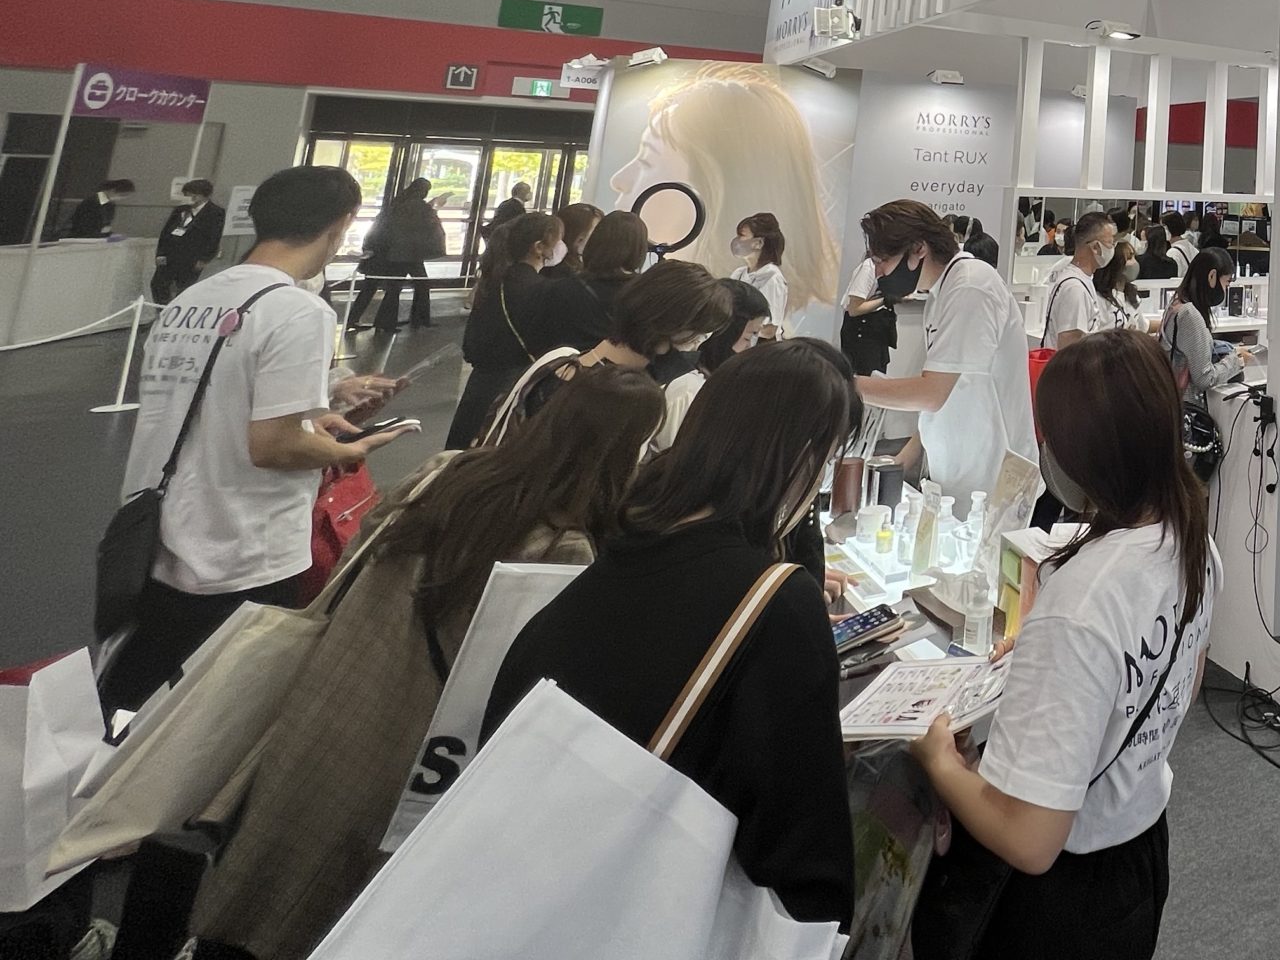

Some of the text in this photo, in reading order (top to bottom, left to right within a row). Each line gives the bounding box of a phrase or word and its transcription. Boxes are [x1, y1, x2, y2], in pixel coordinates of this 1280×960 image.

[115, 84, 206, 108] クロークカウンター
[917, 112, 992, 129] MORRY'S
[913, 147, 989, 165] Tant RUX
[910, 180, 985, 197] everyday
[928, 202, 966, 213] arigato
